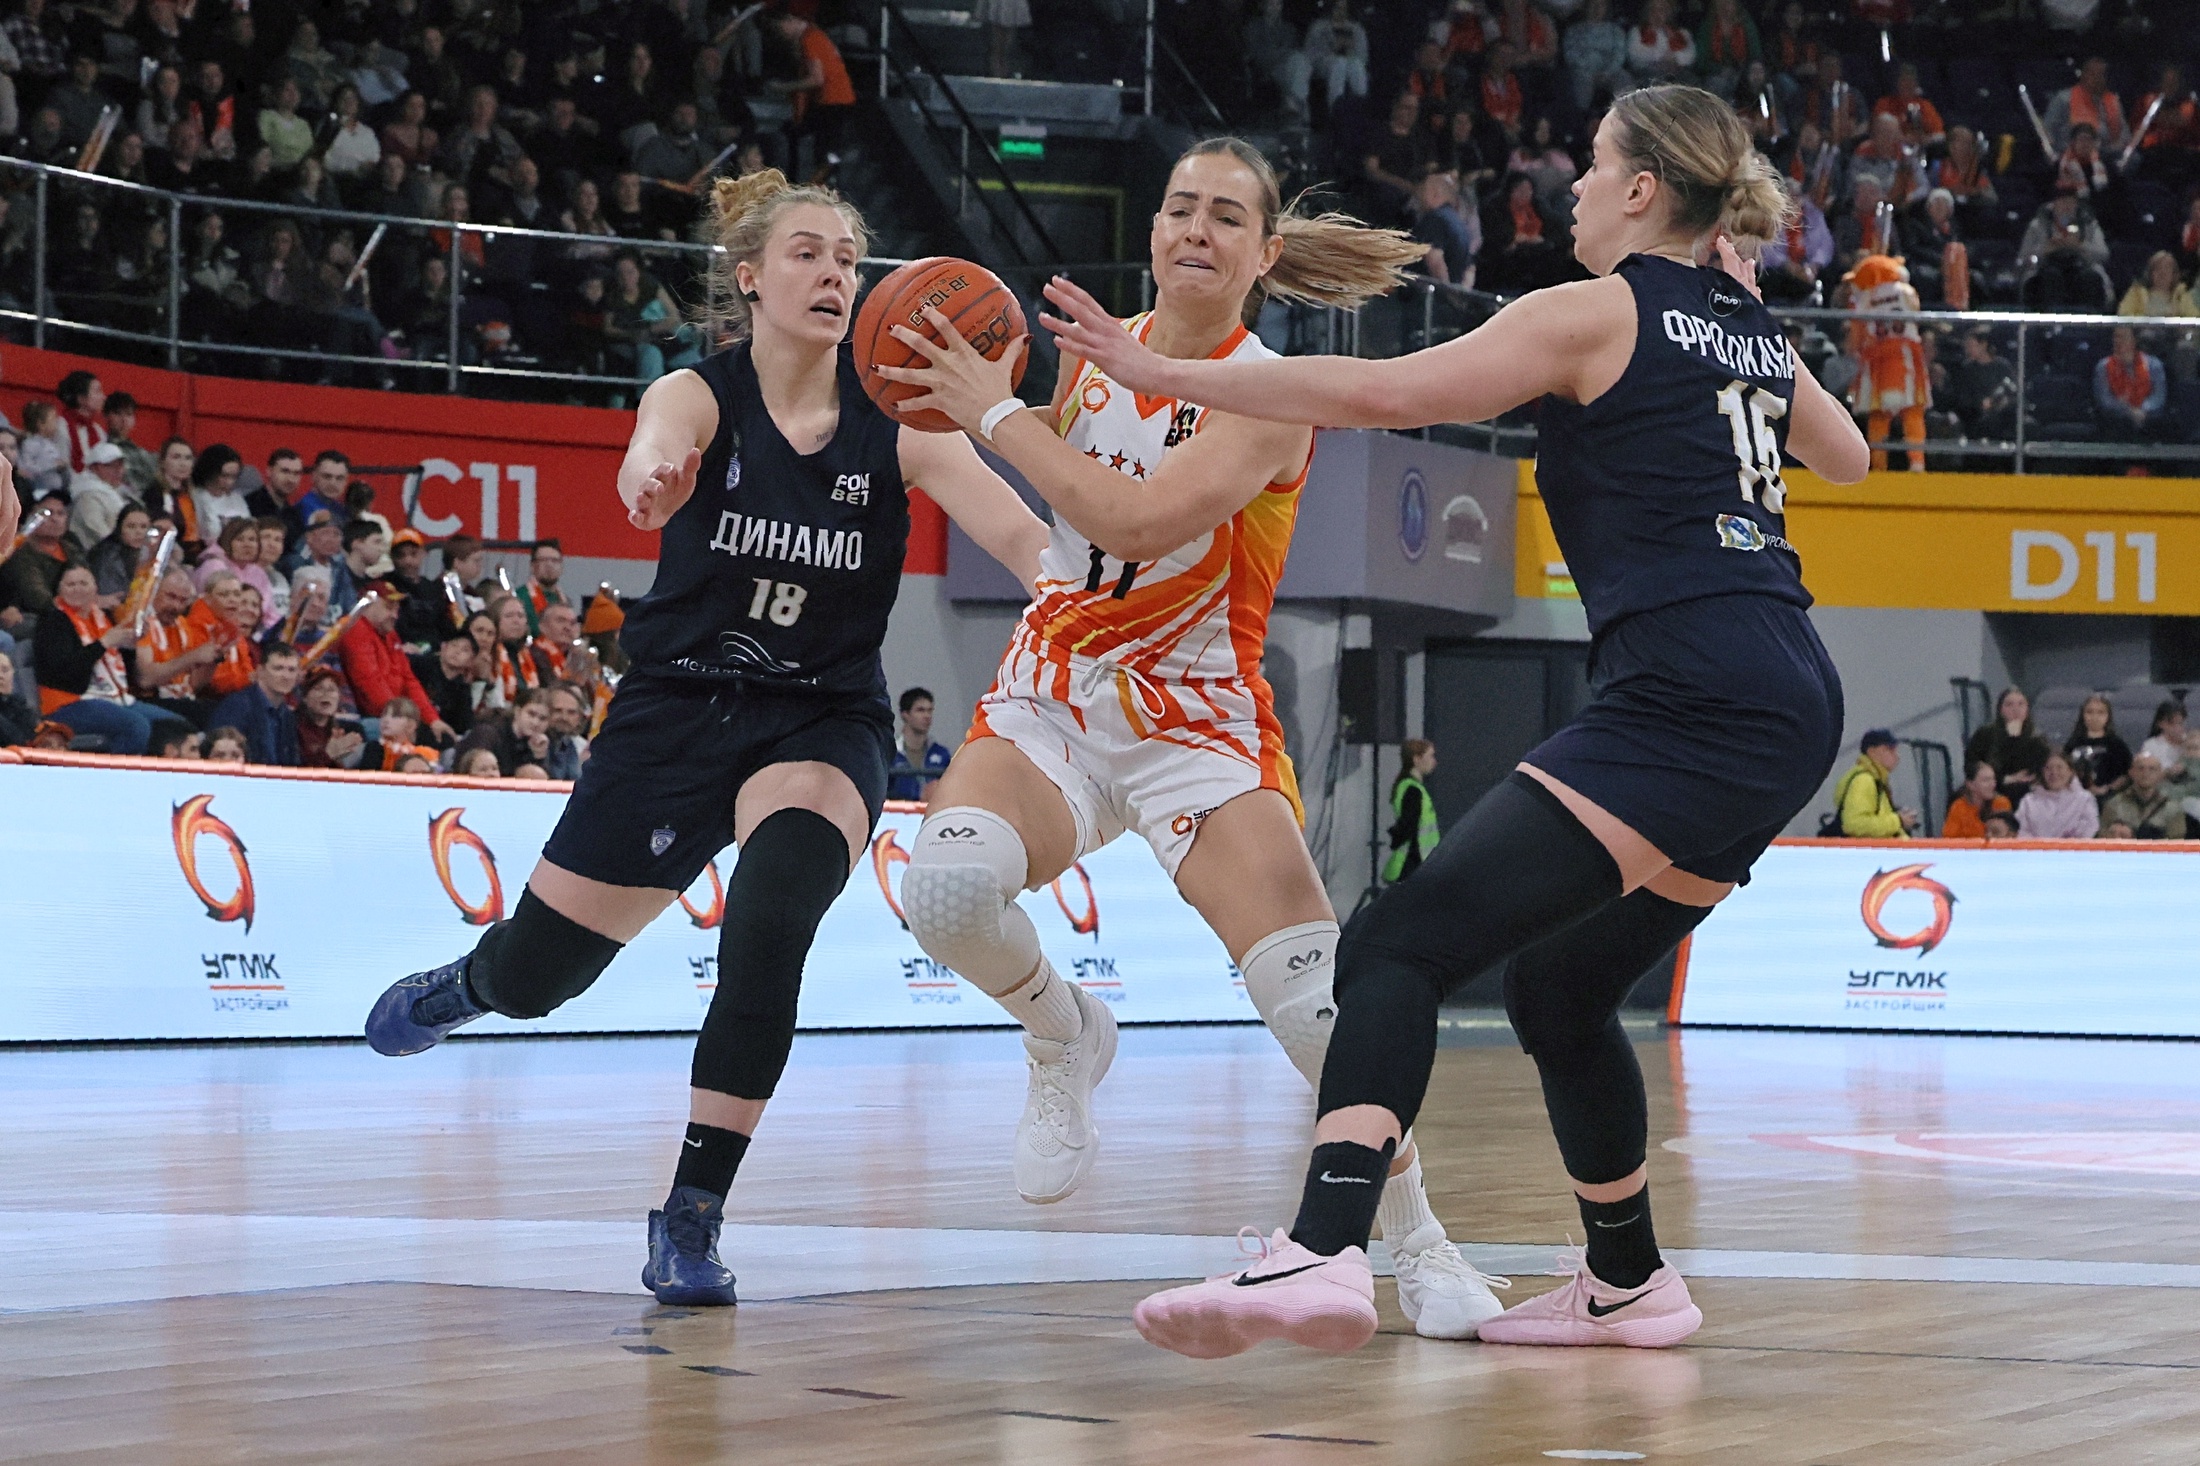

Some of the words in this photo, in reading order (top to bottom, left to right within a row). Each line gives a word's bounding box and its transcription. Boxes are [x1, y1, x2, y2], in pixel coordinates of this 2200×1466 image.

[402, 458, 538, 542] C11
[830, 487, 870, 506] BET
[835, 472, 870, 491] FON
[710, 509, 863, 571] ДИНАМО
[2010, 529, 2157, 603] D11
[747, 577, 808, 628] 18
[201, 953, 281, 979] УГМК
[1847, 970, 1948, 989] УГМК
